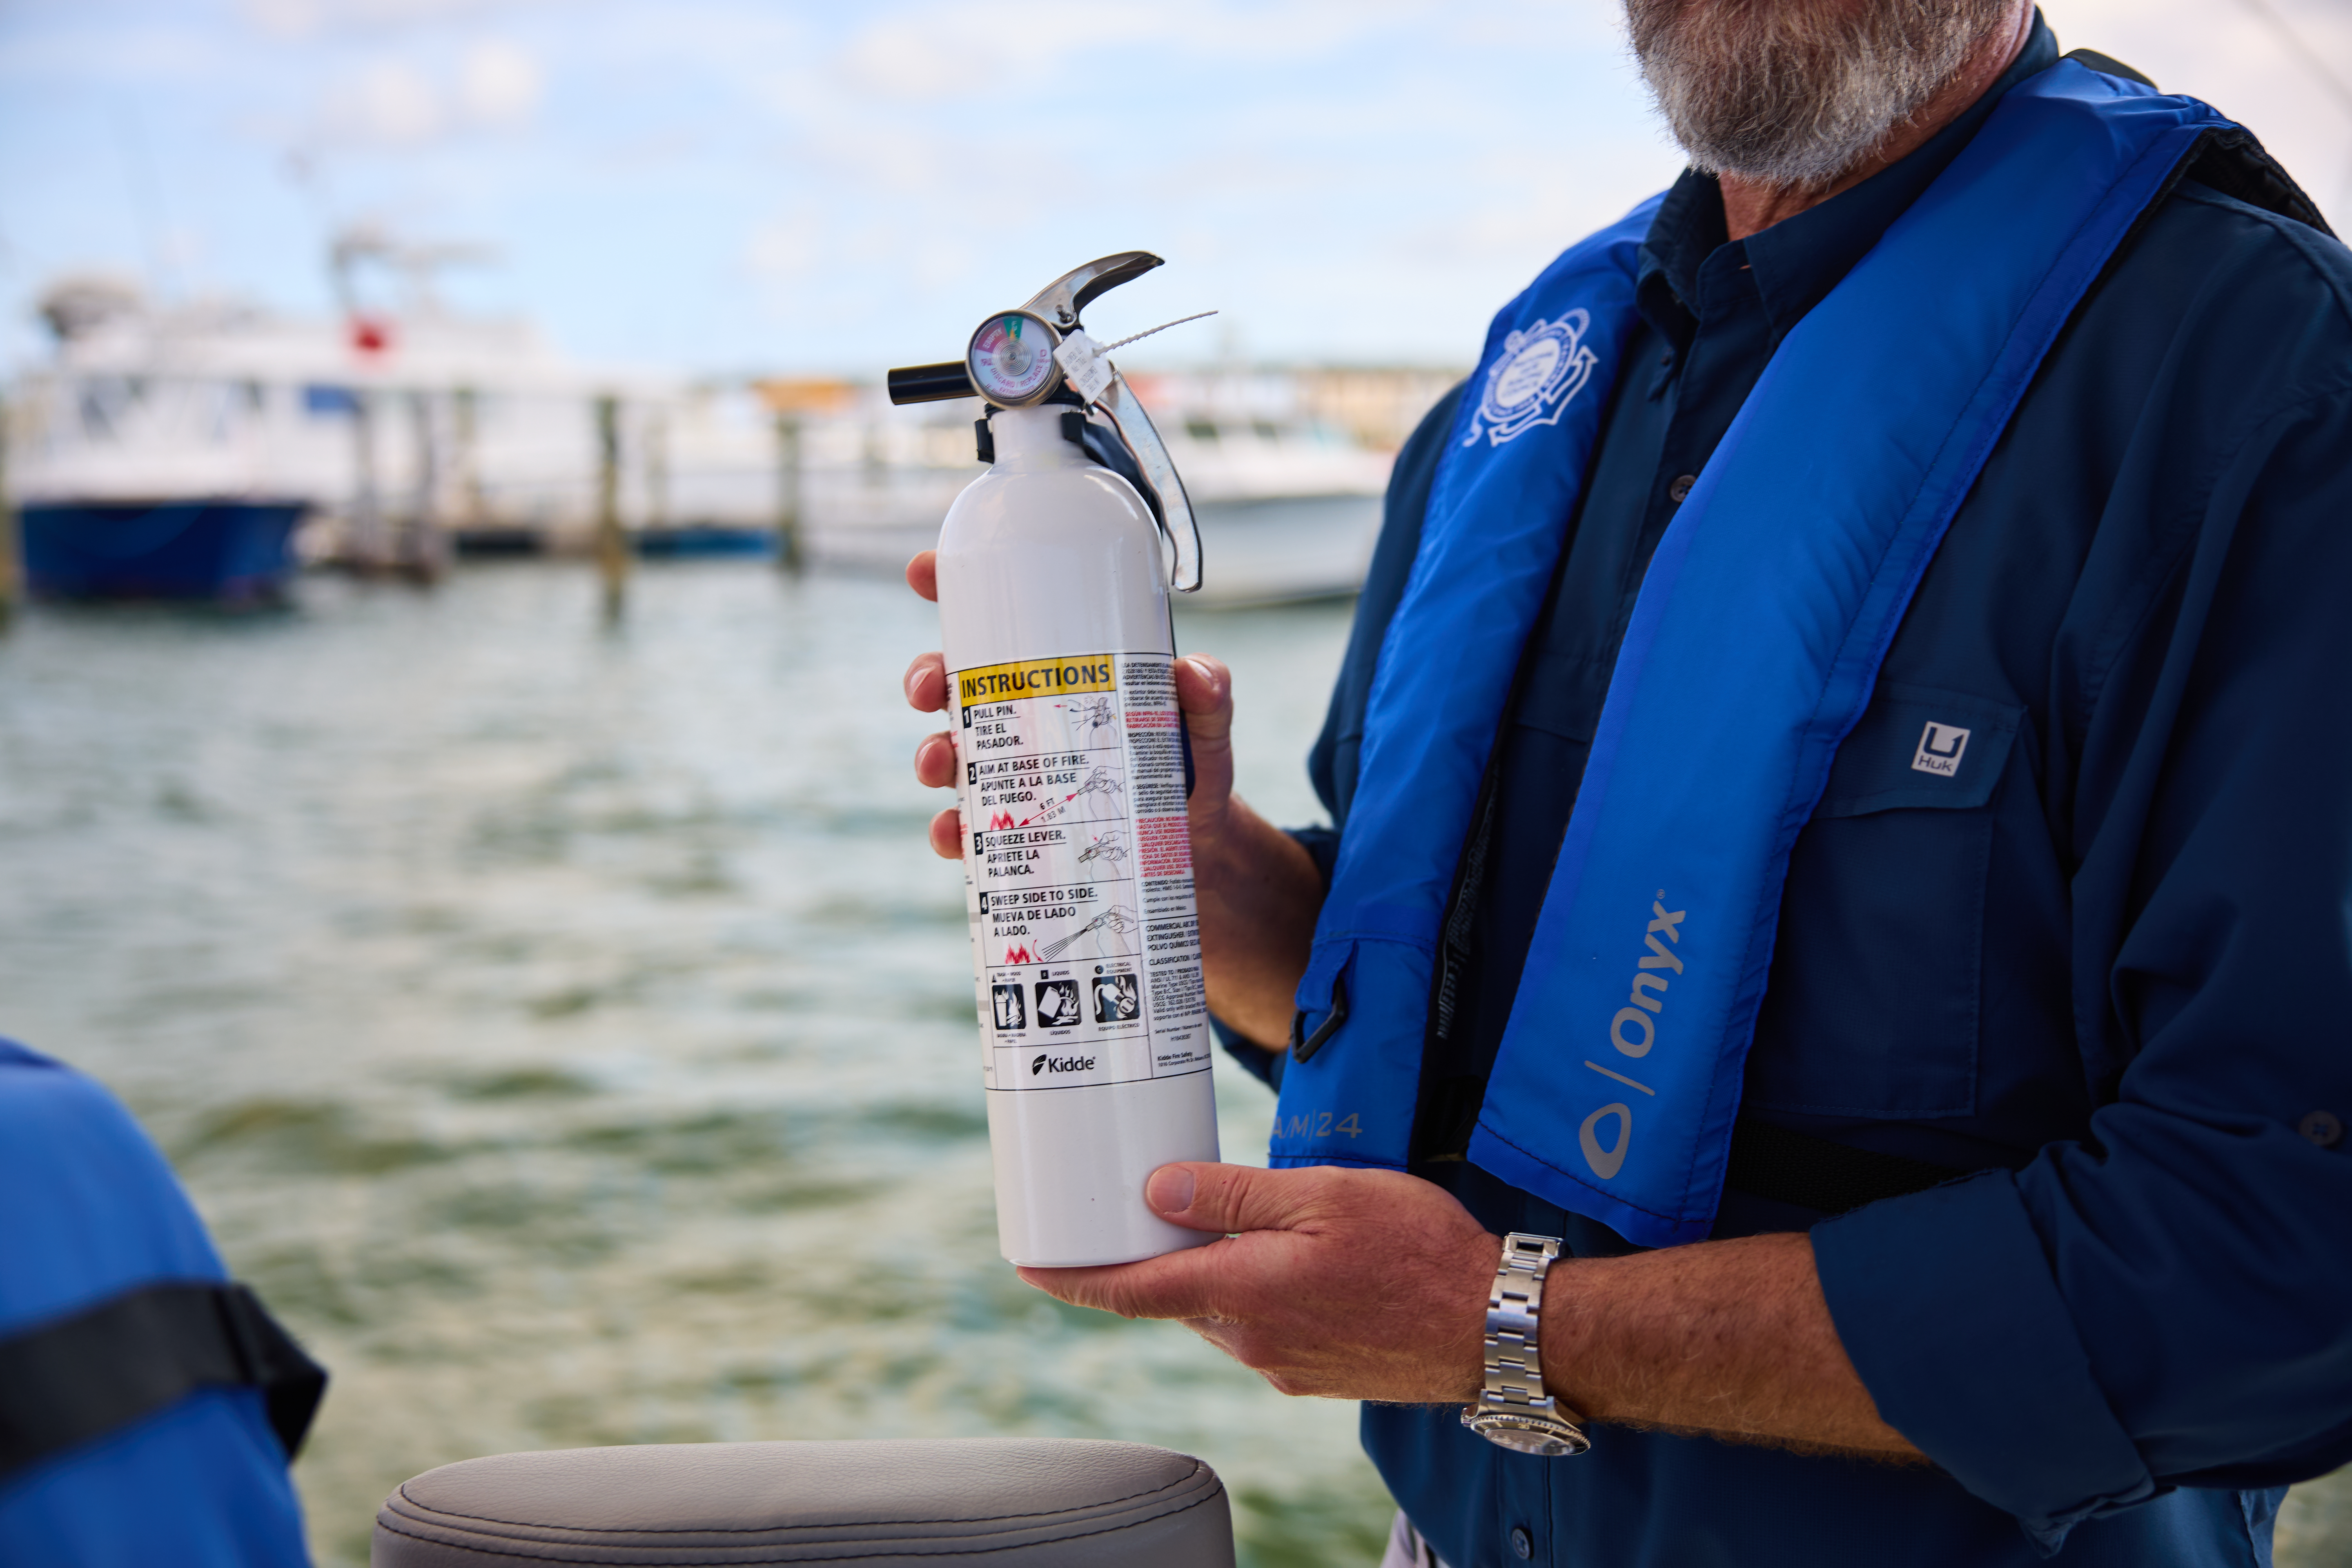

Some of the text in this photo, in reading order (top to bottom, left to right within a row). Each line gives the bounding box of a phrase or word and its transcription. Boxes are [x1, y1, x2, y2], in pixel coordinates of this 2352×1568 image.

[982, 327, 1002, 349] EMPTY
[991, 368, 1015, 388] DISCARD
[1020, 364, 1043, 387] REPLACE
[962, 664, 1109, 698] INSTRUCTIONS
[964, 710, 970, 724] 1
[974, 708, 994, 719] PULL
[997, 705, 1016, 716] PIN.
[975, 723, 1007, 736] TIRE EL
[976, 735, 1024, 750] PASADOR.
[969, 754, 1089, 782] 2 AIM AT BASE OF FIRE.
[1918, 755, 1953, 772] Huk
[981, 772, 1077, 792] APUNTE A LA BASE
[982, 791, 1037, 806] DEL FUEGO.
[1046, 797, 1055, 808] FT
[1040, 806, 1066, 823] 1.83 M
[976, 830, 1066, 851] 3 SQUEEZE LEVER.
[987, 849, 1040, 864] APRIETE LA
[989, 864, 1035, 878] PALANCA.
[981, 887, 1098, 911] 4 SWEEP SIDE TO SIDE.
[993, 907, 1076, 923] MUEVA DE LADO
[994, 925, 1030, 937] A LADO.
[1145, 922, 1183, 932] COMMERCIAL
[1147, 931, 1185, 942] EXTINGUISHER
[1148, 942, 1168, 951] POLVO
[1149, 955, 1191, 965] CLASSIFICATION
[1610, 900, 1686, 1058] Onyx
[1049, 1056, 1095, 1073] Kidde
